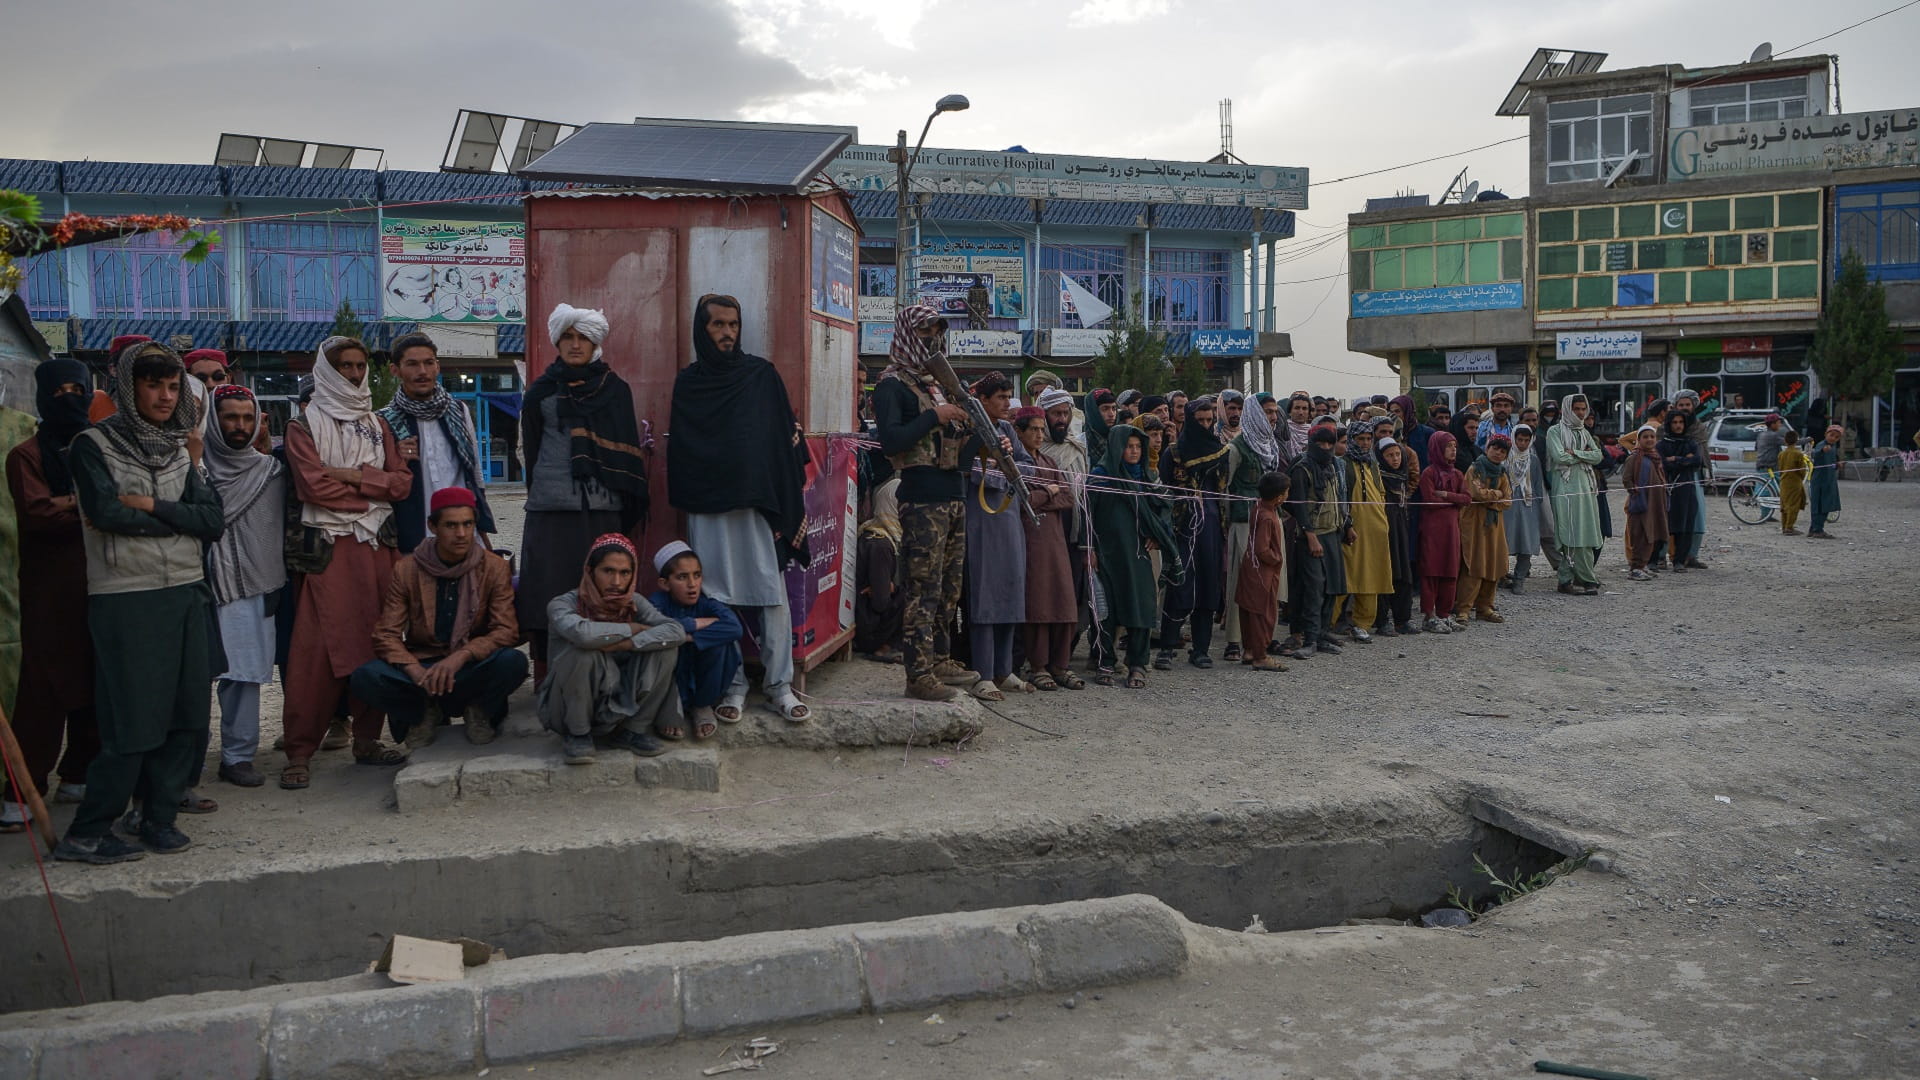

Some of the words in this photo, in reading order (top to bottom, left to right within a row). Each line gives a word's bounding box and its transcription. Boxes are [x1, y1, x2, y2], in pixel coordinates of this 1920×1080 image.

[936, 152, 999, 168] Currative
[1004, 155, 1055, 172] Hospital
[1671, 130, 1742, 176] Ghatool
[1748, 154, 1819, 170] Pharmacy
[1595, 349, 1628, 357] PHARMACY
